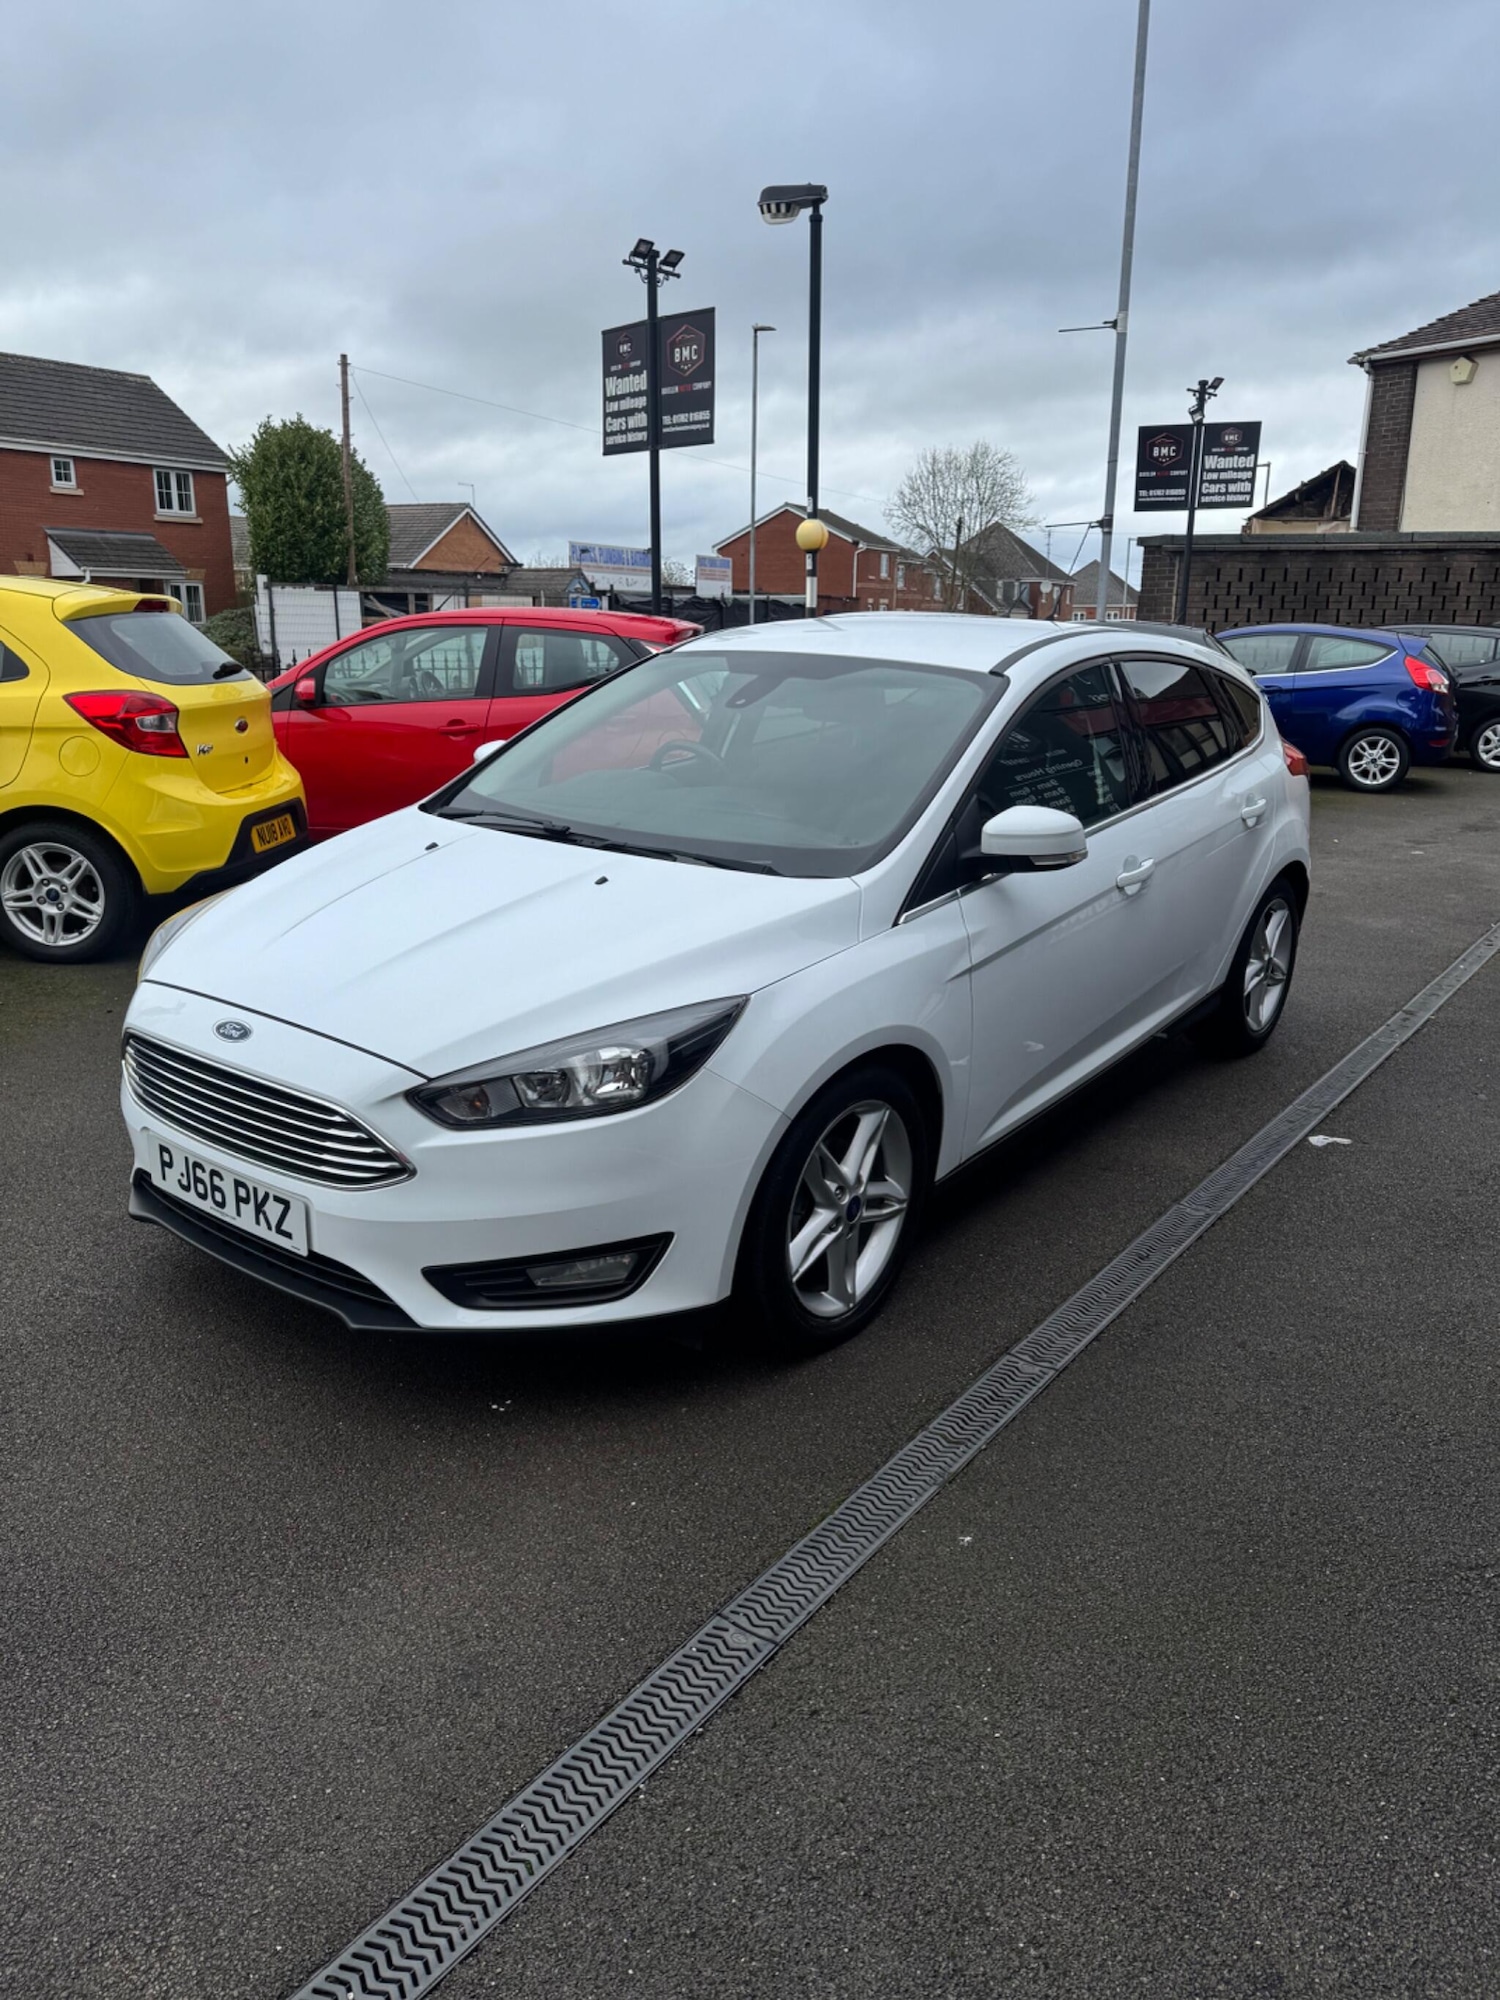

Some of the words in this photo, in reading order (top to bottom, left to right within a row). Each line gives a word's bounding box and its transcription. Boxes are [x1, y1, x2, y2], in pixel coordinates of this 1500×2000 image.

[674, 345, 698, 363] BMC
[605, 370, 648, 397] Wanted
[606, 400, 619, 413] Low
[619, 396, 647, 409] mileage
[606, 416, 627, 432] Cars
[627, 411, 648, 429] with
[605, 434, 627, 445] service
[626, 431, 648, 443] history
[1153, 446, 1177, 457] BMC
[1204, 454, 1255, 469] Wanted
[1203, 471, 1219, 480] Low
[1219, 470, 1253, 480] mileage
[1202, 482, 1227, 494] Cars
[1228, 481, 1252, 493] with
[1201, 495, 1226, 503] service
[1226, 494, 1251, 503] history
[219, 1022, 245, 1038] Ford
[158, 1144, 227, 1210] PJ66
[233, 1178, 294, 1240] PKZ
